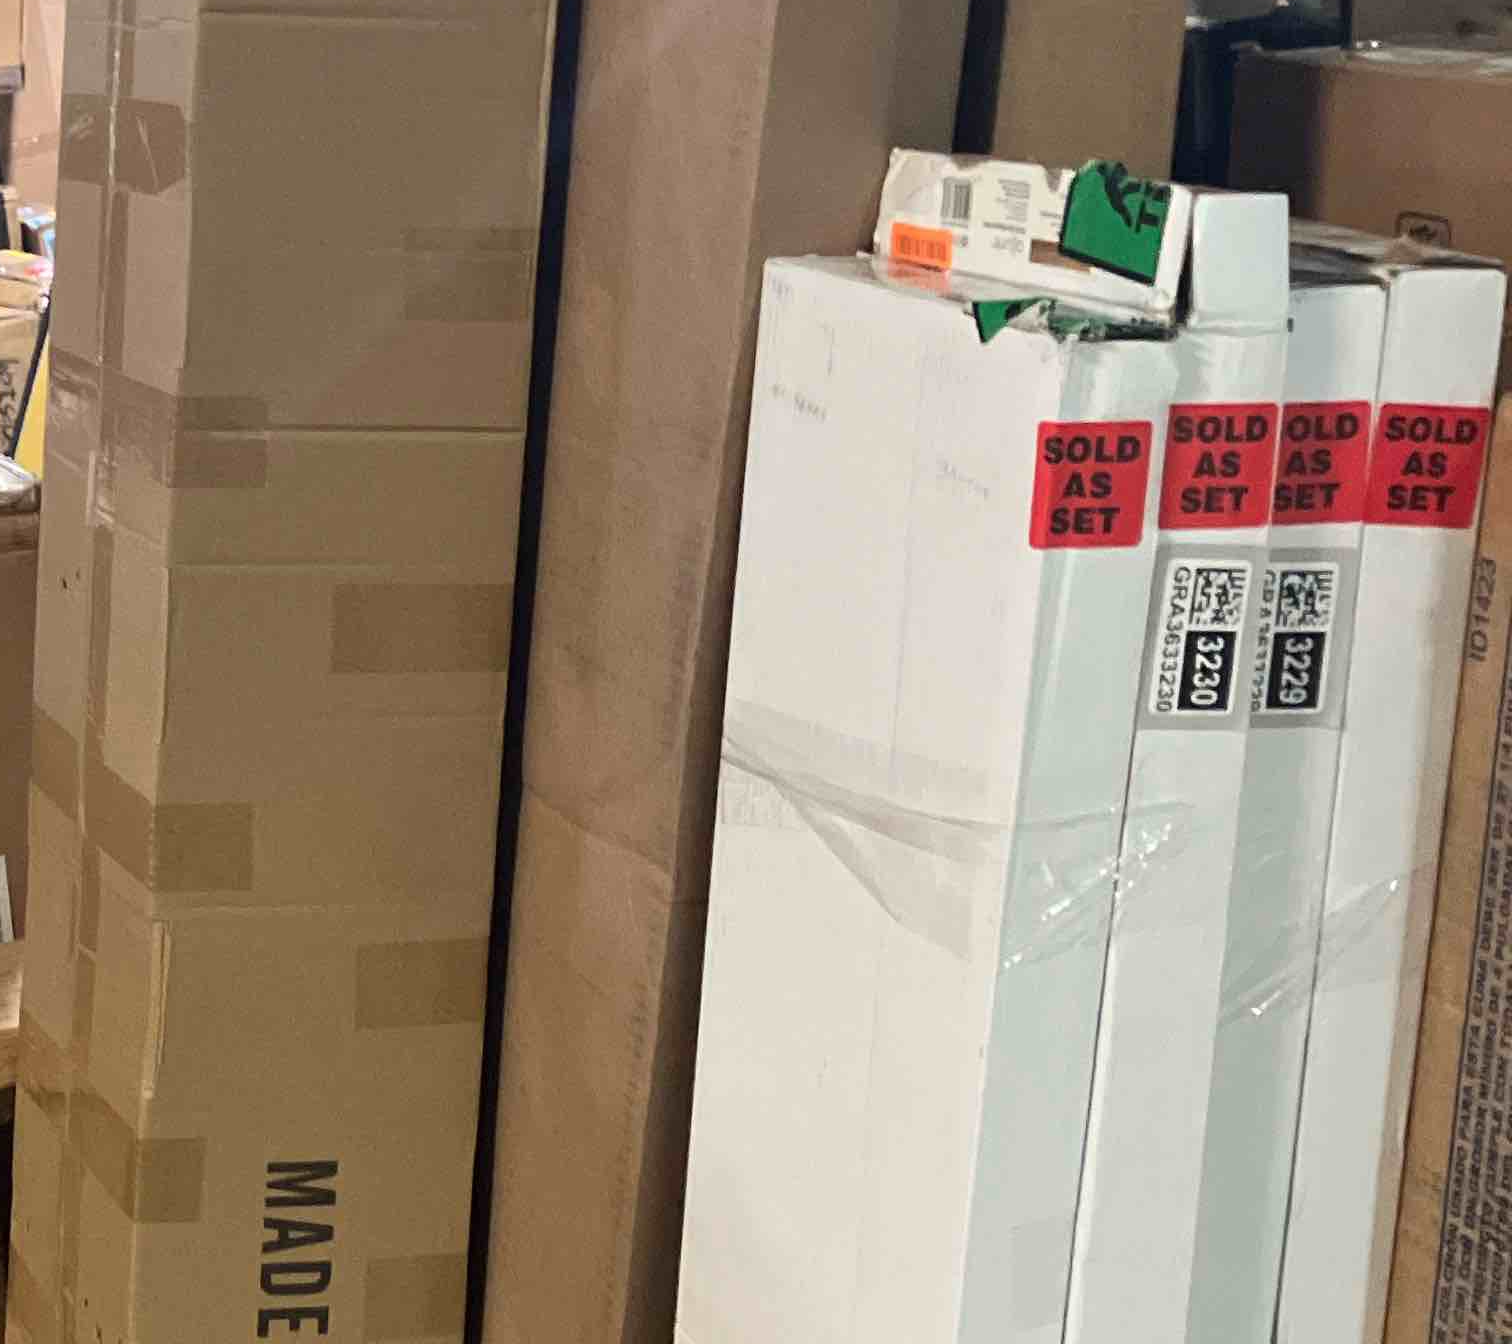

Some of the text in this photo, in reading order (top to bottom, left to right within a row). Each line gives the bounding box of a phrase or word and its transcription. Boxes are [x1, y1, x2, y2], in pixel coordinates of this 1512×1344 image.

[1173, 414, 1271, 443] SOLD
[1284, 413, 1360, 440] OLD
[1384, 416, 1480, 443] SOLD
[1045, 435, 1141, 464] SOLD
[1285, 448, 1331, 475] AS
[1193, 451, 1241, 478] AS
[1401, 451, 1447, 478] AS
[1063, 472, 1113, 499] AS
[1180, 485, 1249, 513] SET
[1272, 483, 1341, 513] SET
[1387, 485, 1456, 513] SET
[1050, 507, 1120, 536] SET
[1471, 559, 1496, 662] ID1423
[1156, 566, 1191, 713] GRA3633230
[1190, 636, 1225, 705] 3230
[1280, 637, 1313, 706] 3229
[257, 1160, 339, 1338] MADE
